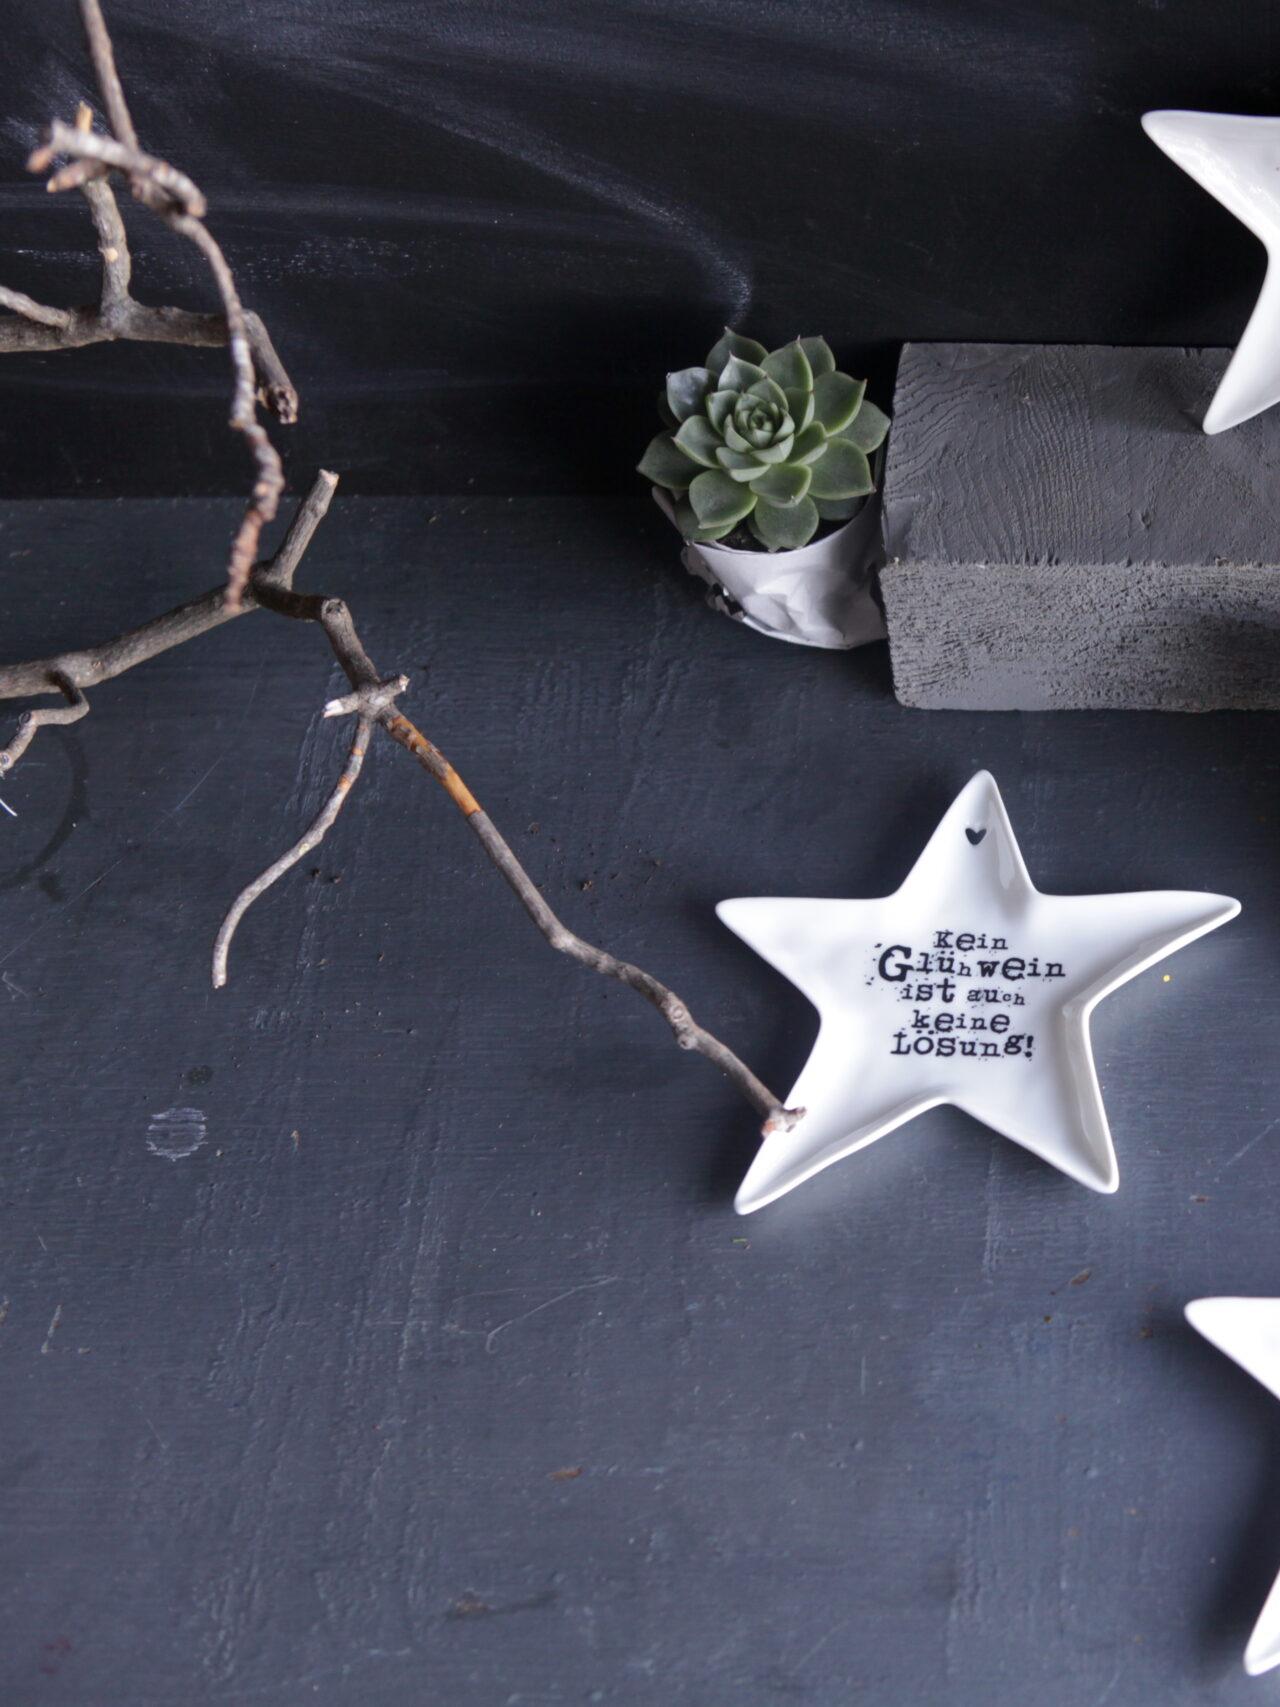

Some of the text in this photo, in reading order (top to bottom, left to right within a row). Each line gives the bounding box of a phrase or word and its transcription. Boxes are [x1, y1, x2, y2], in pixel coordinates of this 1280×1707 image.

[933, 930, 1008, 951] Kein
[878, 945, 1065, 982] Glühwein
[901, 978, 1025, 1006] ist auch
[911, 1009, 1010, 1034] keine
[890, 1030, 1034, 1058] Lösung!
